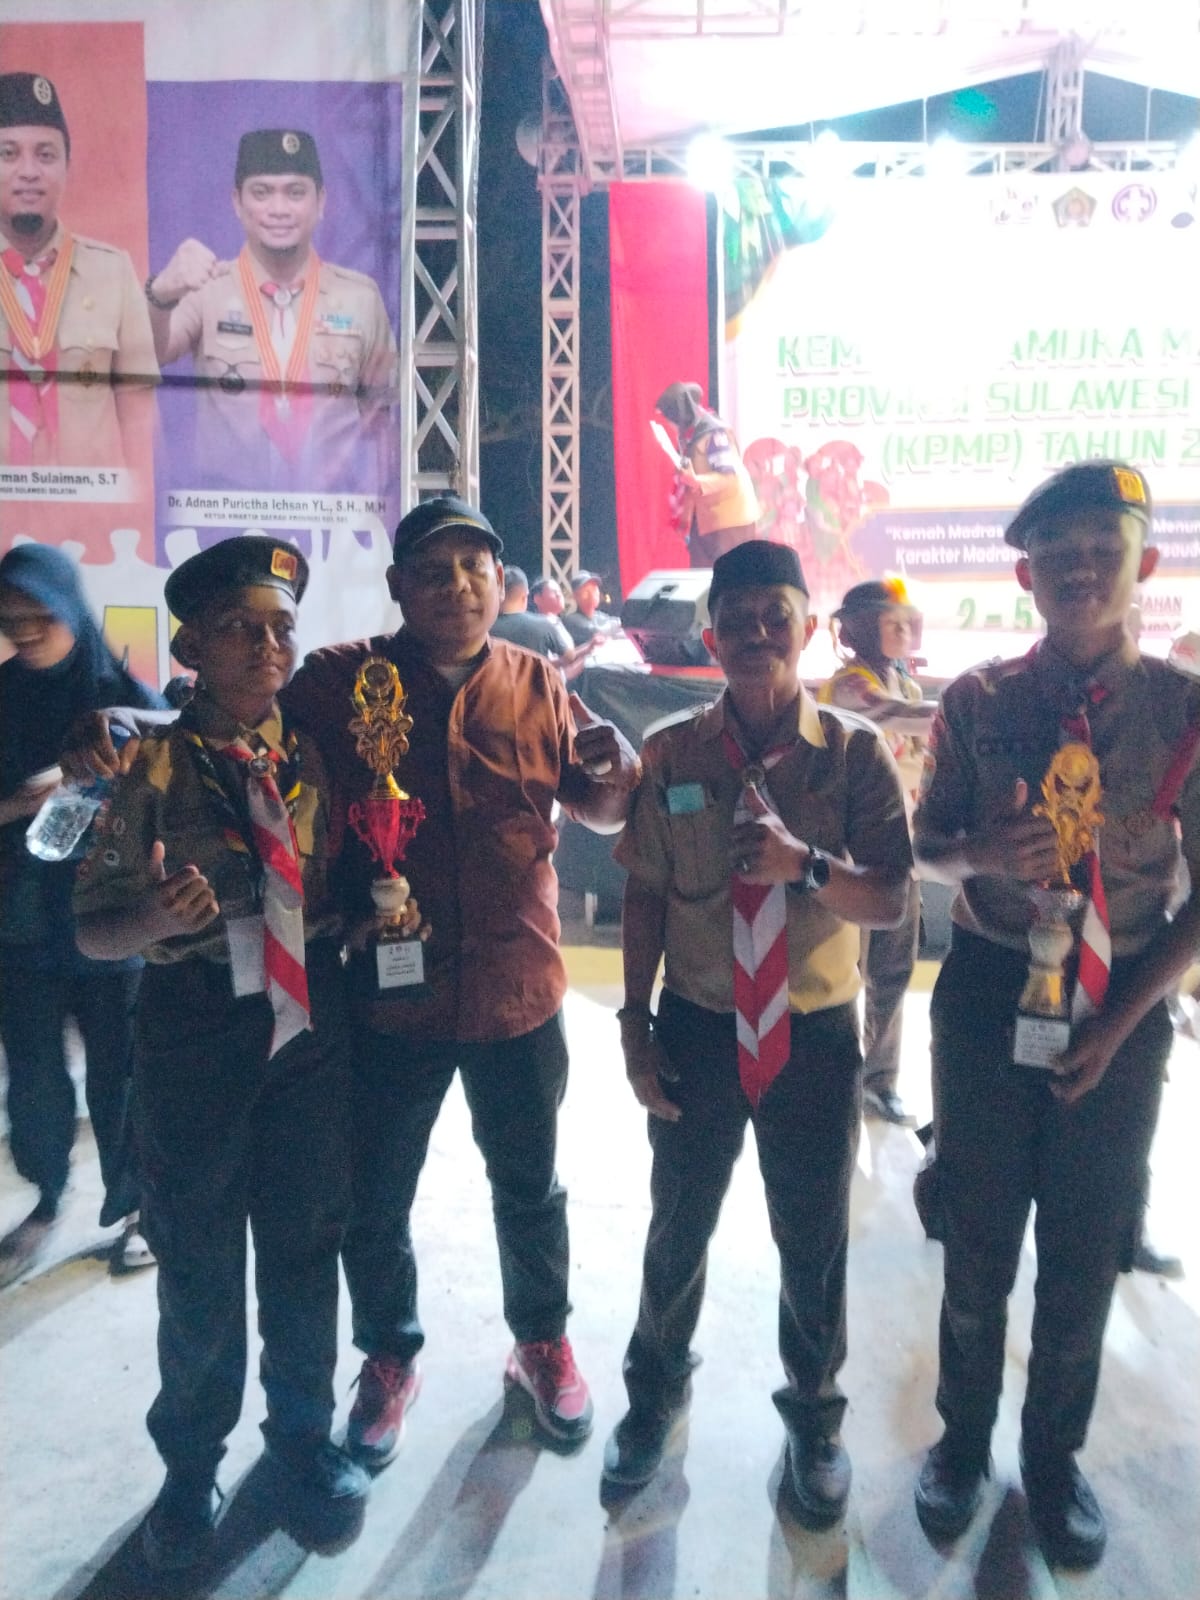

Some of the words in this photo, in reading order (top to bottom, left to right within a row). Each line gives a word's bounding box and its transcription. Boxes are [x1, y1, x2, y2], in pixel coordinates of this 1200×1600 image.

[985, 375, 1191, 415] SULAWESI
[881, 428, 1024, 475] (KPMP)
[1039, 428, 1167, 465] TAHUN
[31, 472, 95, 487] Sulaiman,
[98, 473, 119, 485] S.T
[168, 495, 182, 508] Dr.
[185, 496, 219, 508] Adnan
[222, 497, 269, 511] Purictha
[272, 498, 309, 511] Ichsan
[948, 523, 1005, 540] Madras
[895, 546, 961, 565] Karakter
